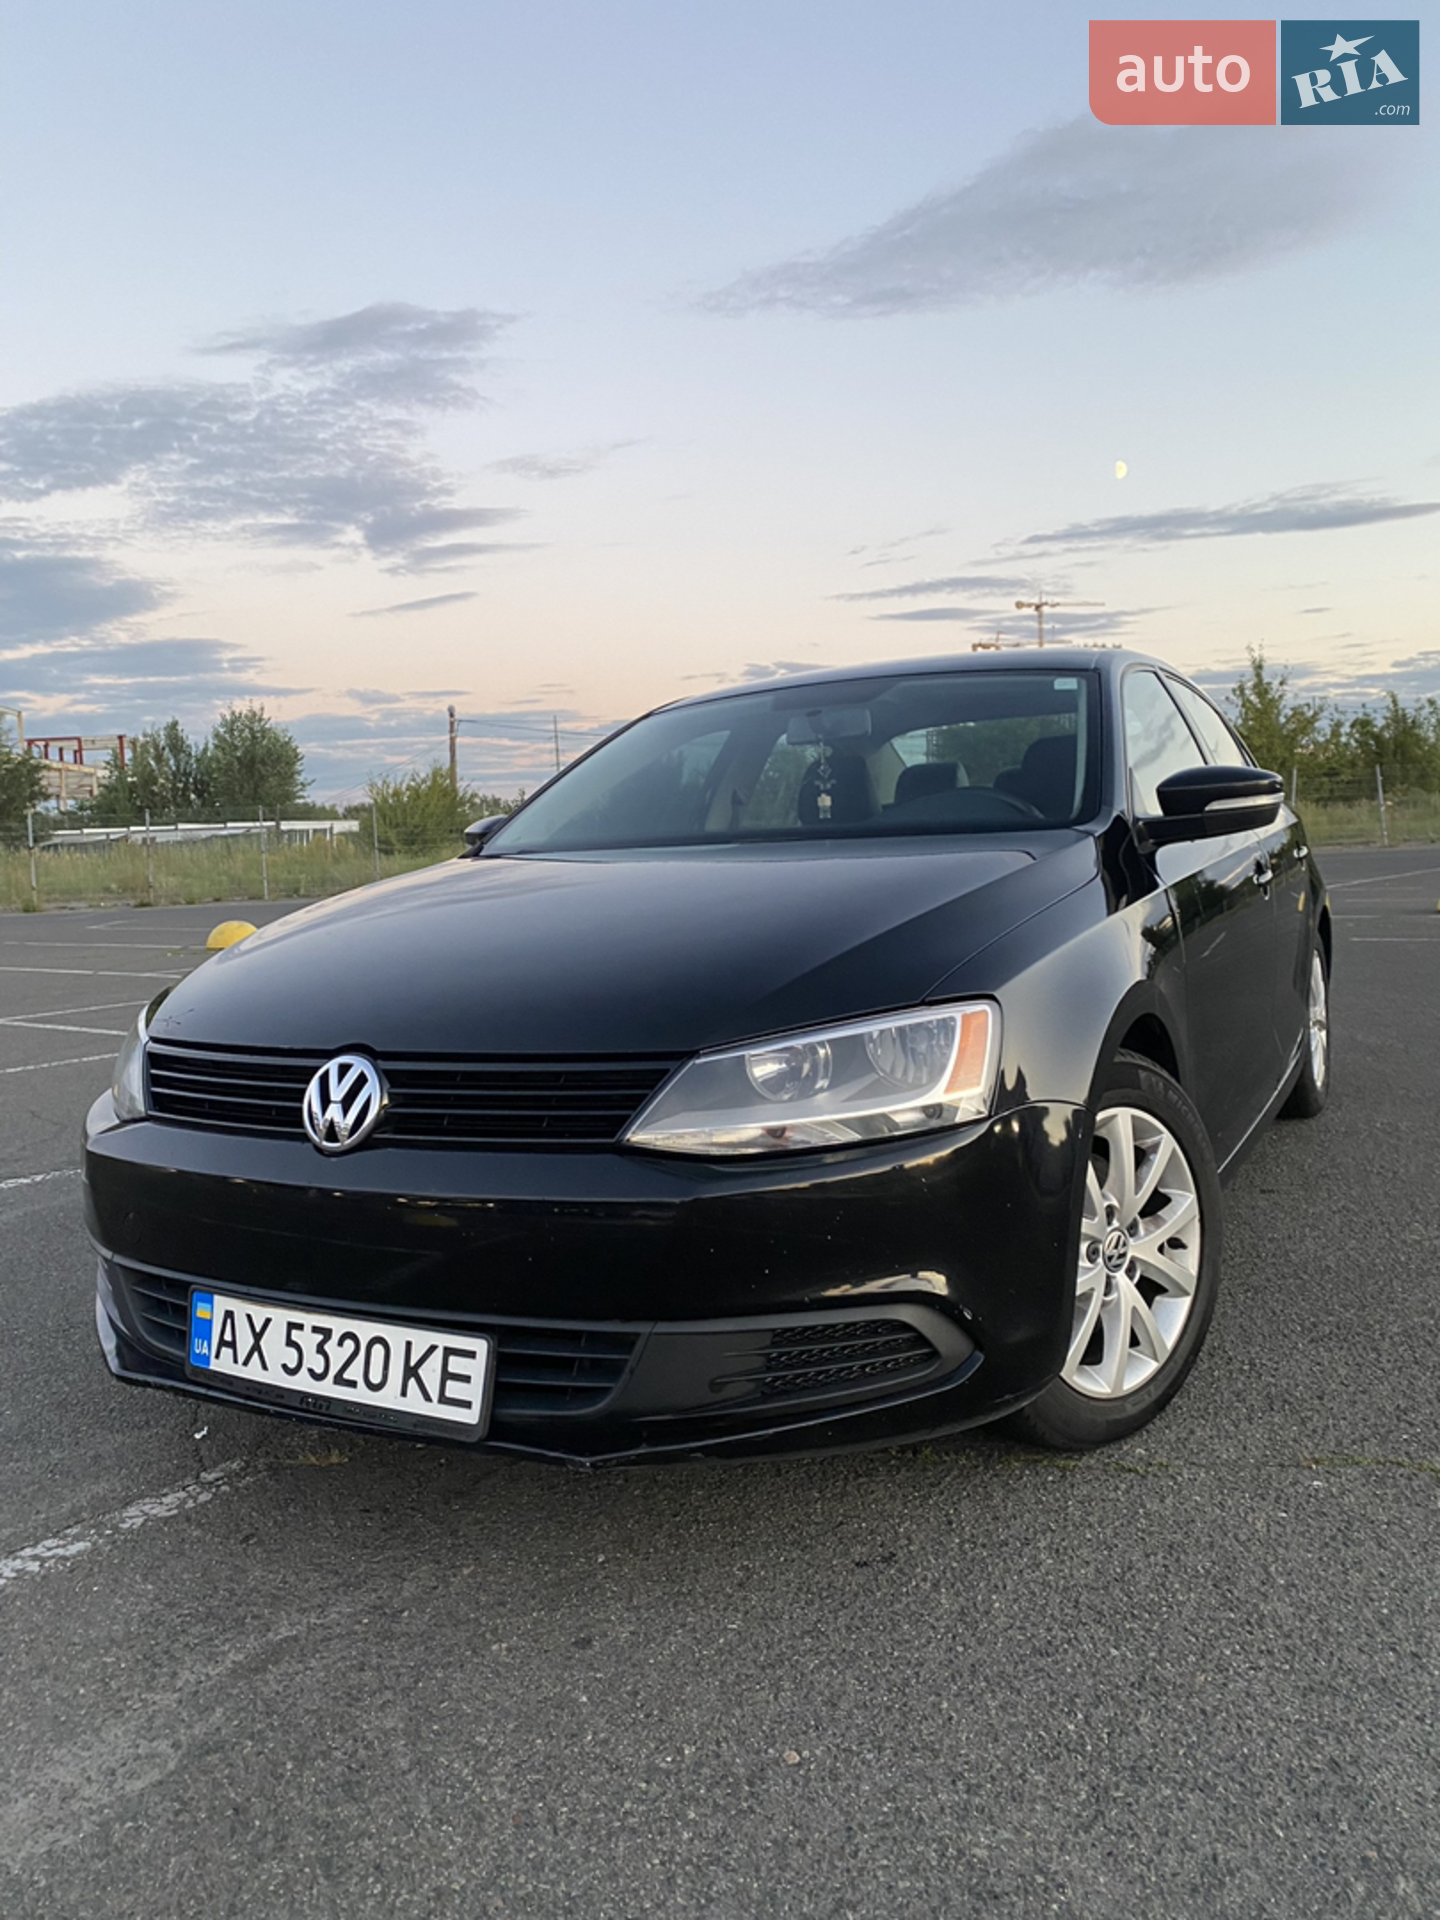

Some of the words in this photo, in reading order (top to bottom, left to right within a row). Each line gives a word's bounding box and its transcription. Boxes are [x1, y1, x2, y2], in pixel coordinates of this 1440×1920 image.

[195, 1337, 210, 1357] UA
[214, 1309, 273, 1372] AX
[280, 1320, 392, 1393] 5320
[400, 1340, 477, 1410] KE
